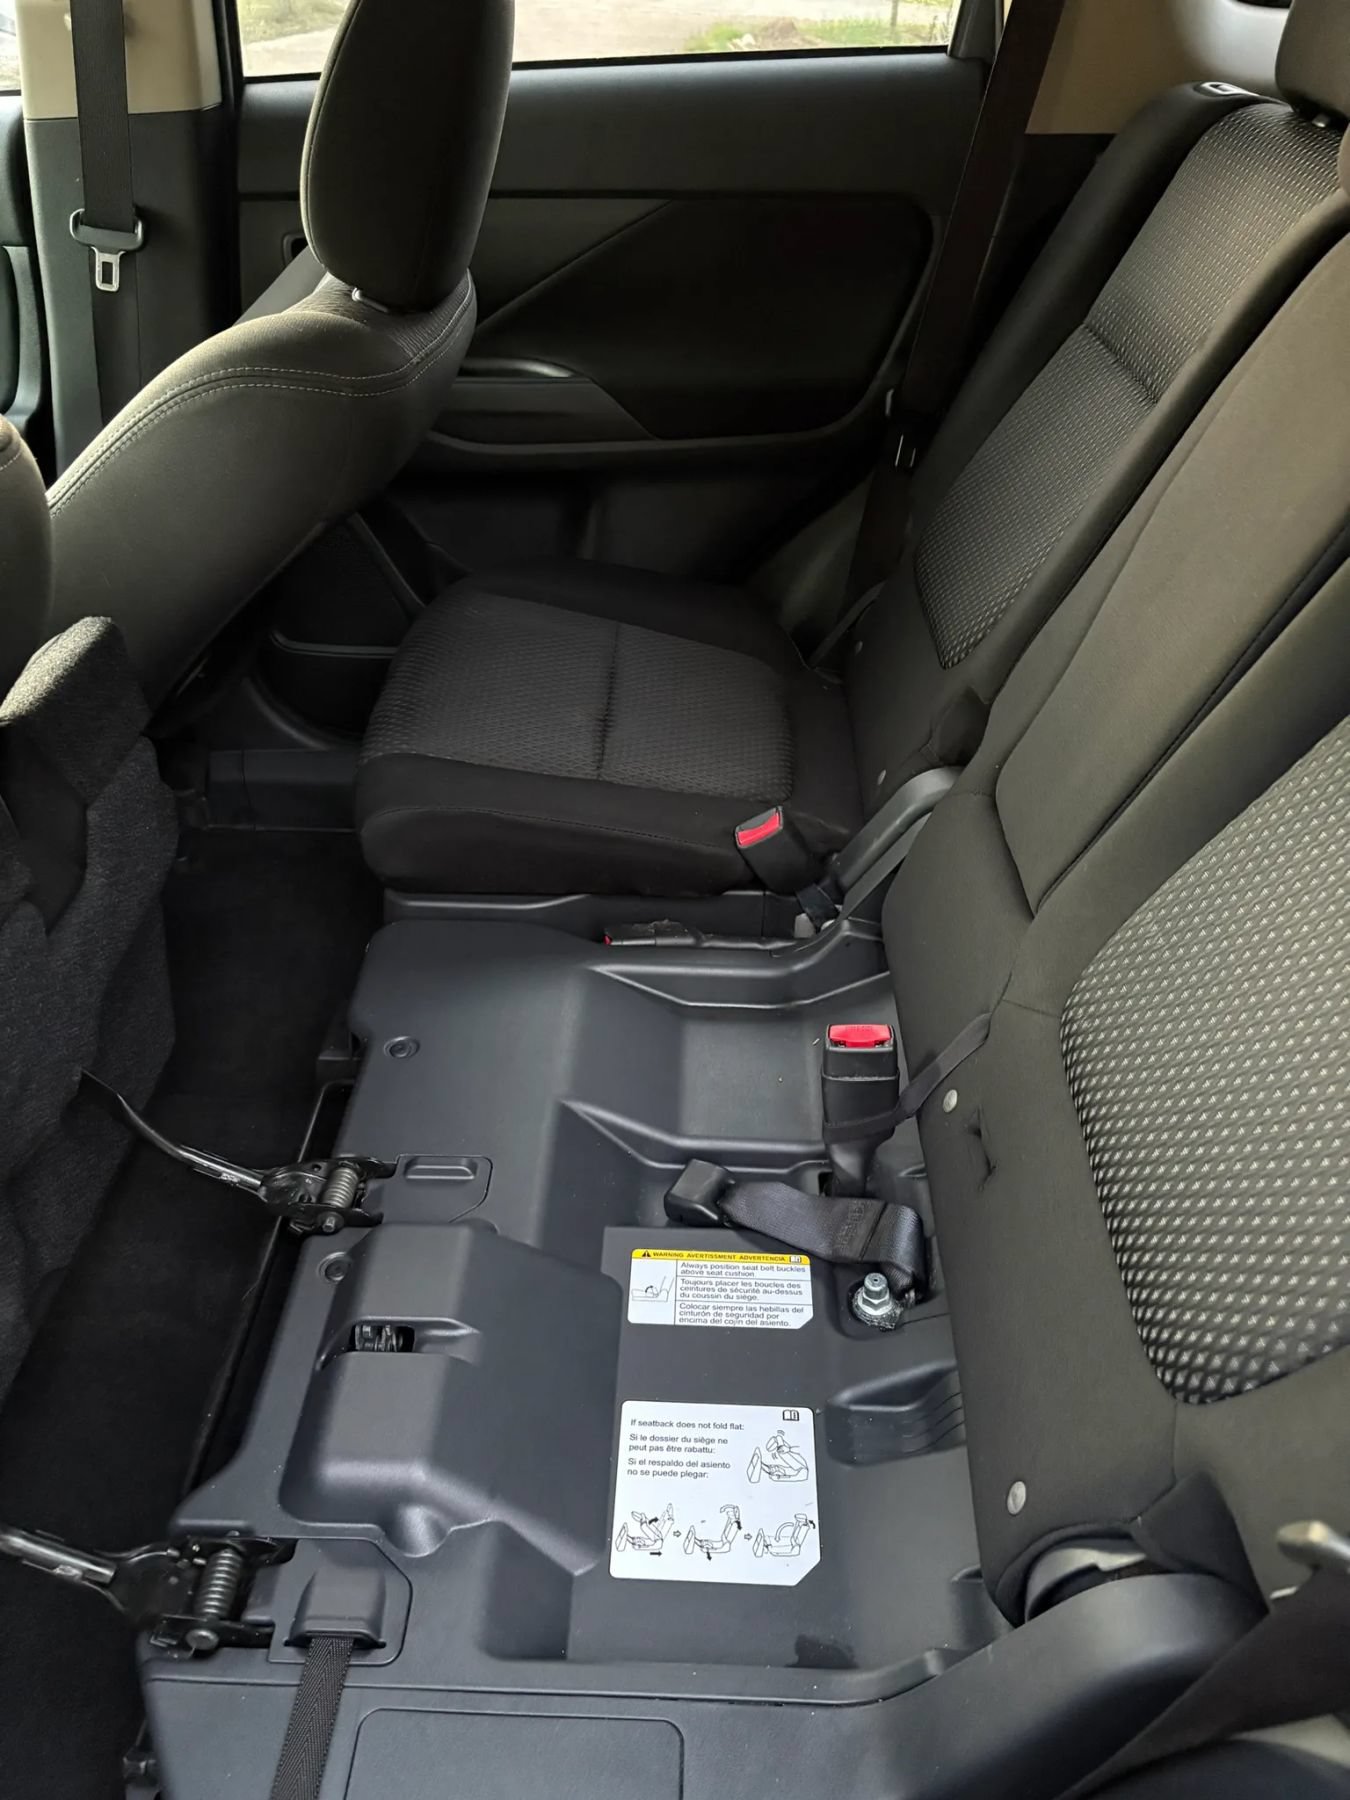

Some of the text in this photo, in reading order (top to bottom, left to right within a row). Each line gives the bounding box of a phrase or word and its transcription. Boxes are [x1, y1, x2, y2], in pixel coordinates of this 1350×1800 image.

[712, 1304, 744, 1312] siempre
[713, 1422, 728, 1430] fold
[629, 1433, 638, 1441] Si
[649, 1434, 679, 1442] dossier
[693, 1436, 716, 1445] siège
[628, 1444, 647, 1452] peut
[648, 1445, 664, 1453] pas
[628, 1457, 637, 1465] Si
[648, 1459, 684, 1468] respaldo
[685, 1460, 699, 1468] del
[700, 1461, 731, 1469] asiento
[652, 1470, 679, 1478] puede
